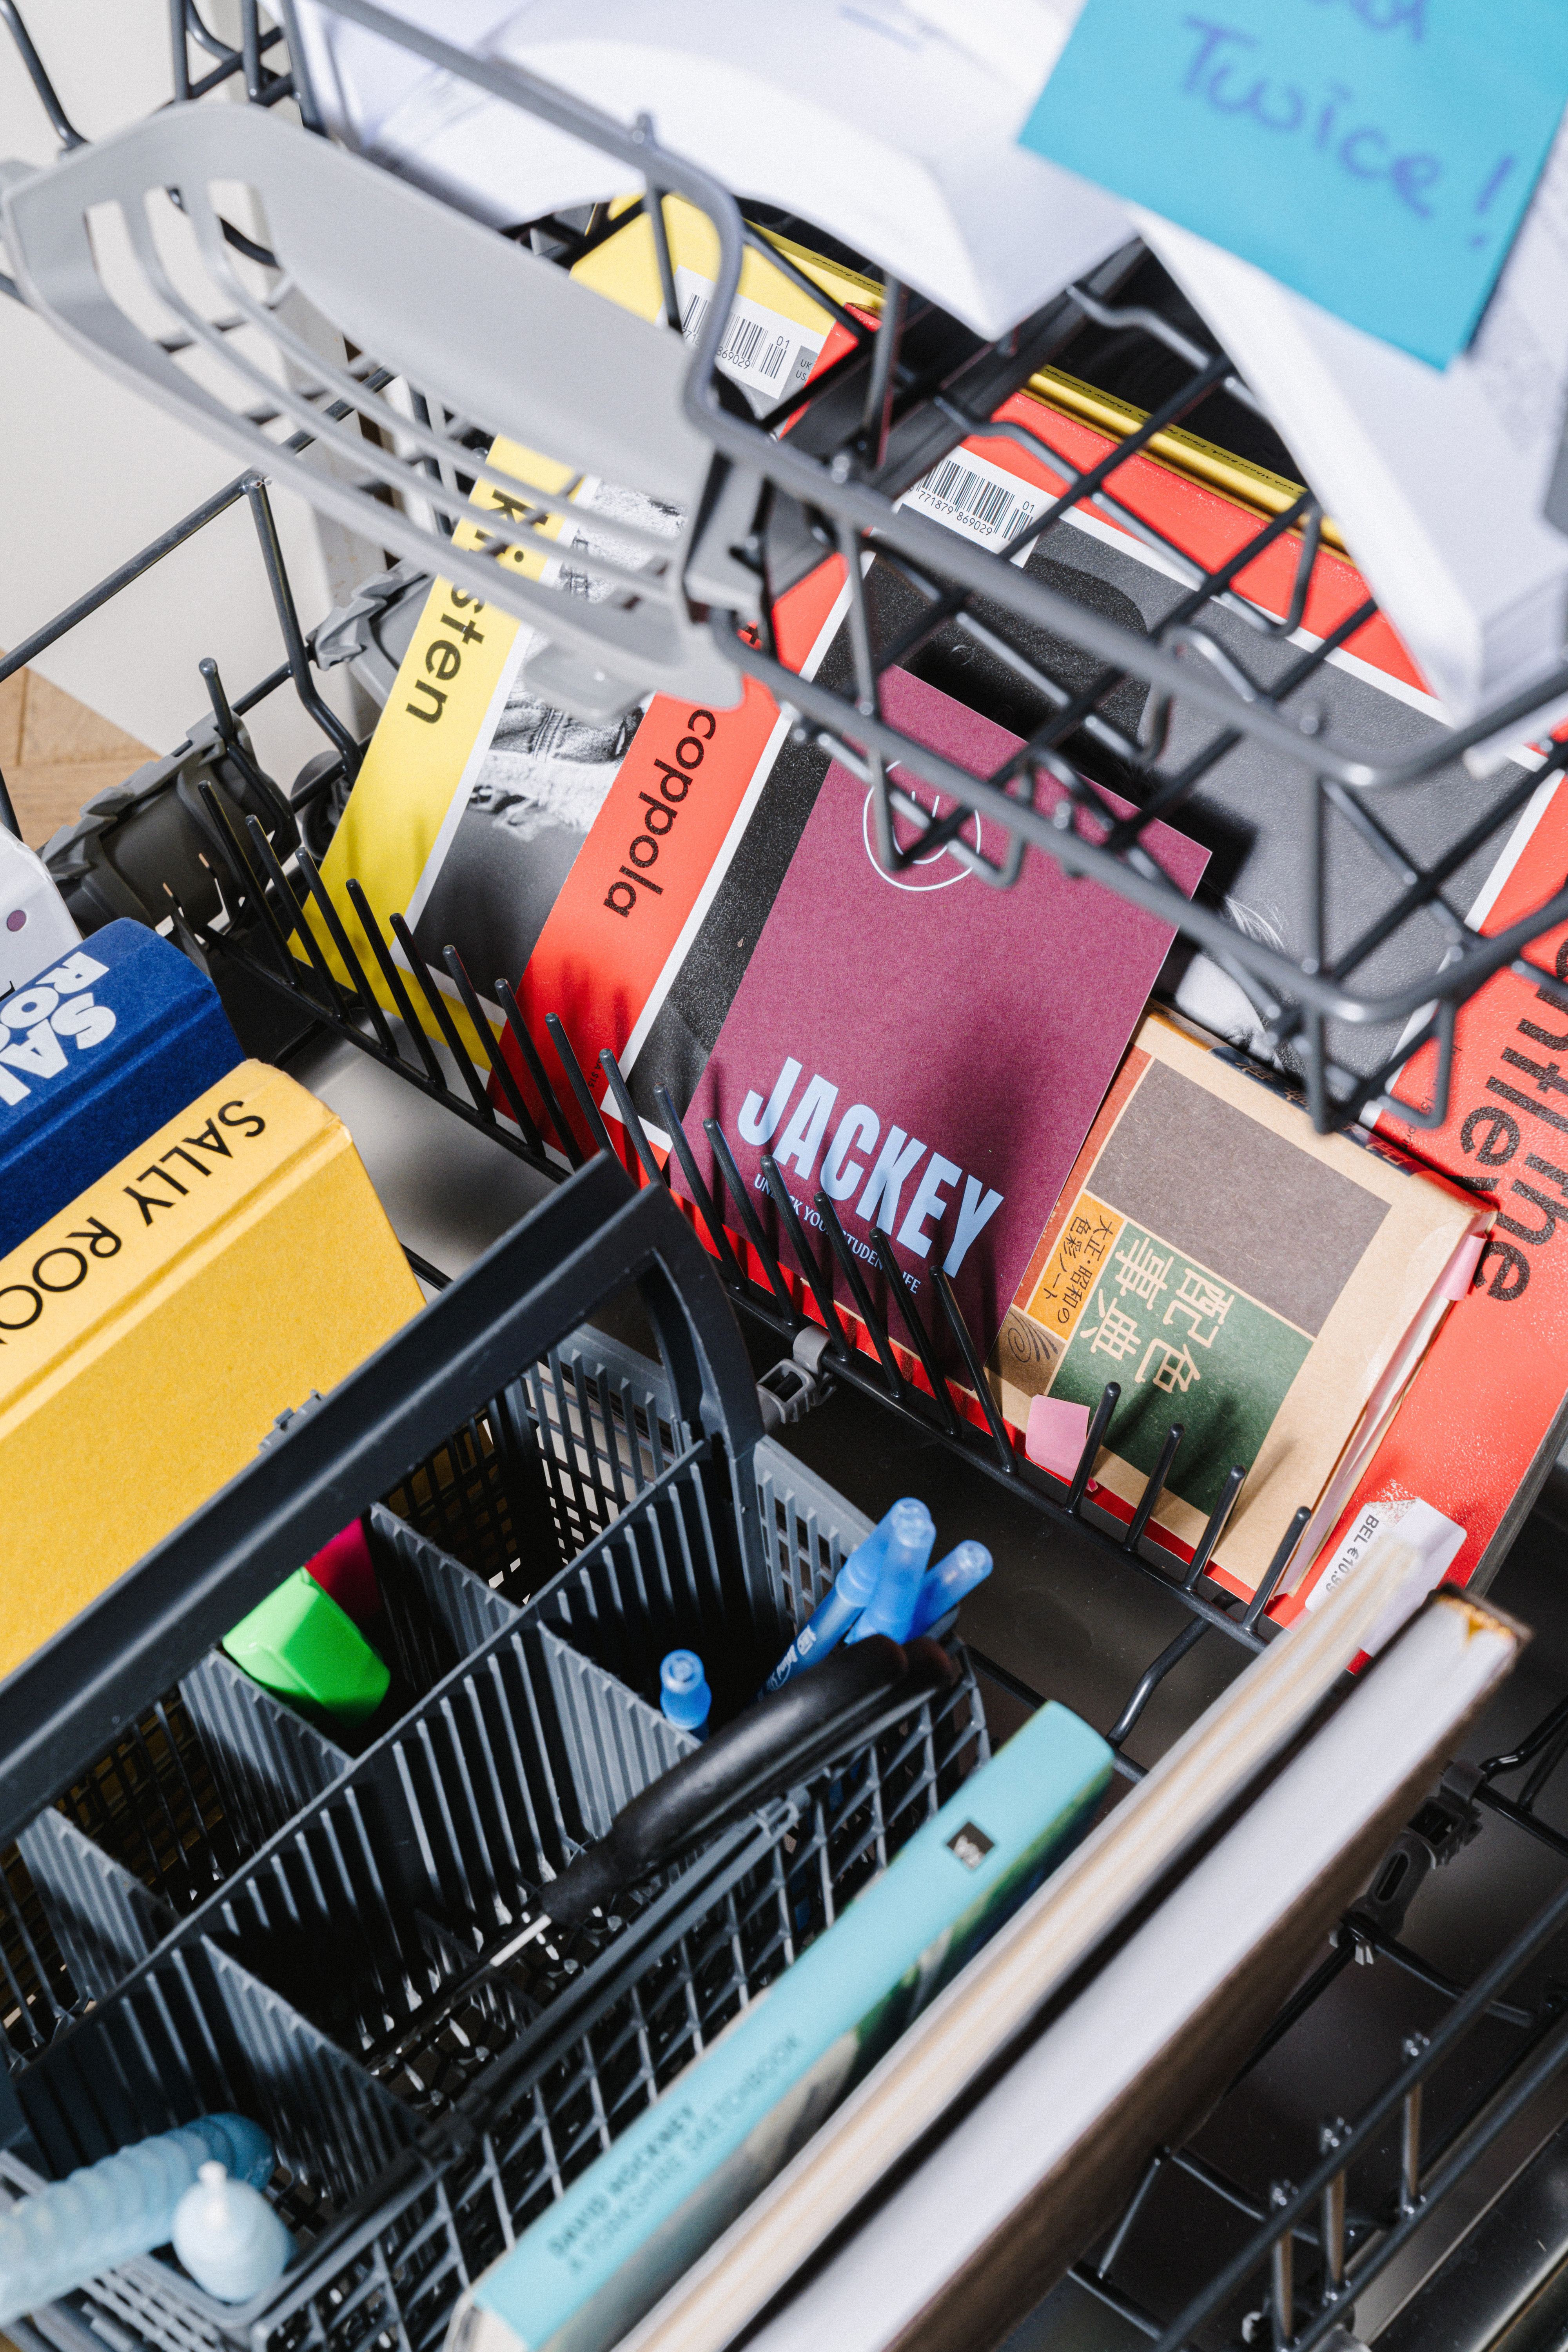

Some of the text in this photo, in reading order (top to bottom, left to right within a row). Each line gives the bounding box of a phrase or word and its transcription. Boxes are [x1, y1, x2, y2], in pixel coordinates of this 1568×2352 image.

[776, 336, 790, 350] 01
[795, 370, 809, 381] US
[800, 359, 812, 370] UK
[1095, 393, 1132, 413] Whitney
[1180, 434, 1207, 448] Elena
[918, 490, 954, 515] 771879
[956, 512, 993, 536] 869029
[1022, 501, 1035, 514] 01
[405, 488, 549, 724] kisten
[603, 707, 717, 918] coppola
[737, 1056, 1004, 1278] JACKEY
[0, 1100, 266, 1345] SALLY ROO
[803, 1205, 829, 1235] YOU
[1043, 1216, 1092, 1299] 色彩ノート
[1057, 1215, 1114, 1325] 大正・昭和の
[1080, 1236, 1174, 1361] 事典
[1134, 1268, 1234, 1394] 配色
[1325, 1514, 1380, 1593] BEL €10.99
